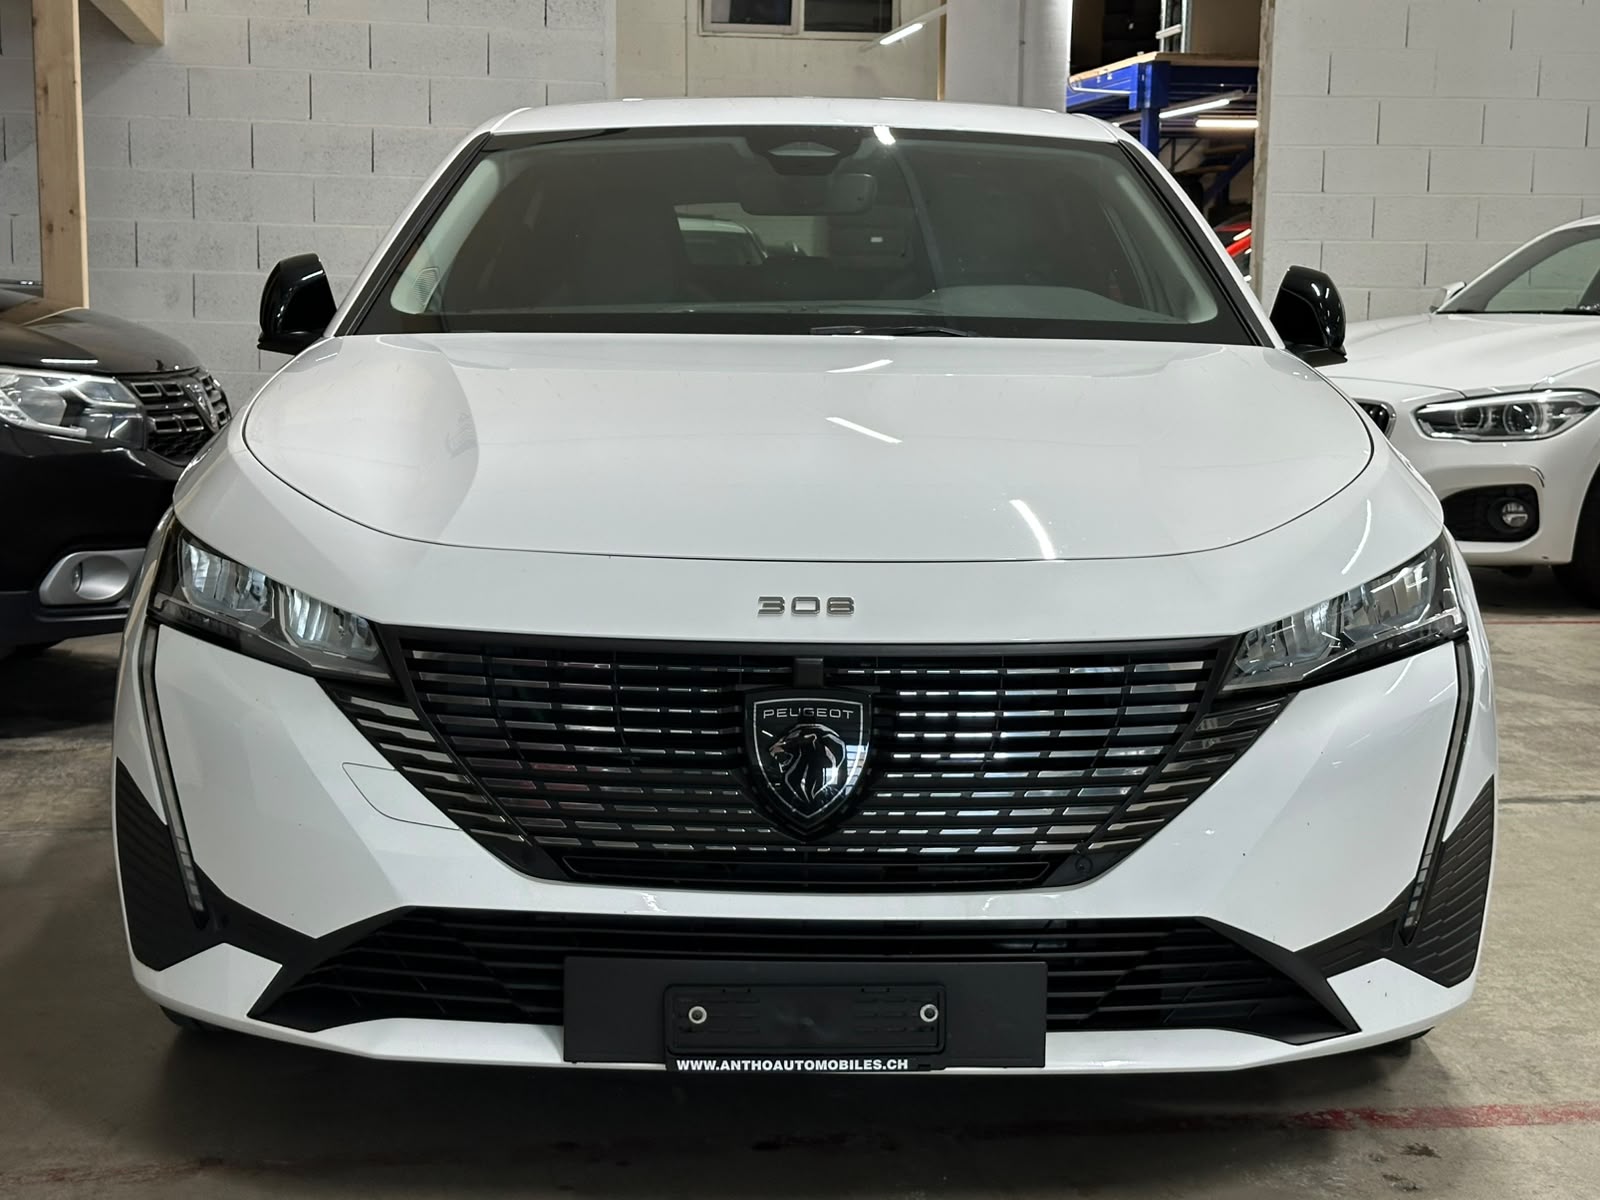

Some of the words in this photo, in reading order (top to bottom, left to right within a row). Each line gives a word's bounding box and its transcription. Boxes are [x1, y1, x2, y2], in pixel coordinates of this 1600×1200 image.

[757, 596, 855, 616] 308
[763, 707, 854, 719] PEUGEOT
[676, 1059, 909, 1072] WWW.ANTHOAUTOMOBILES.CH
